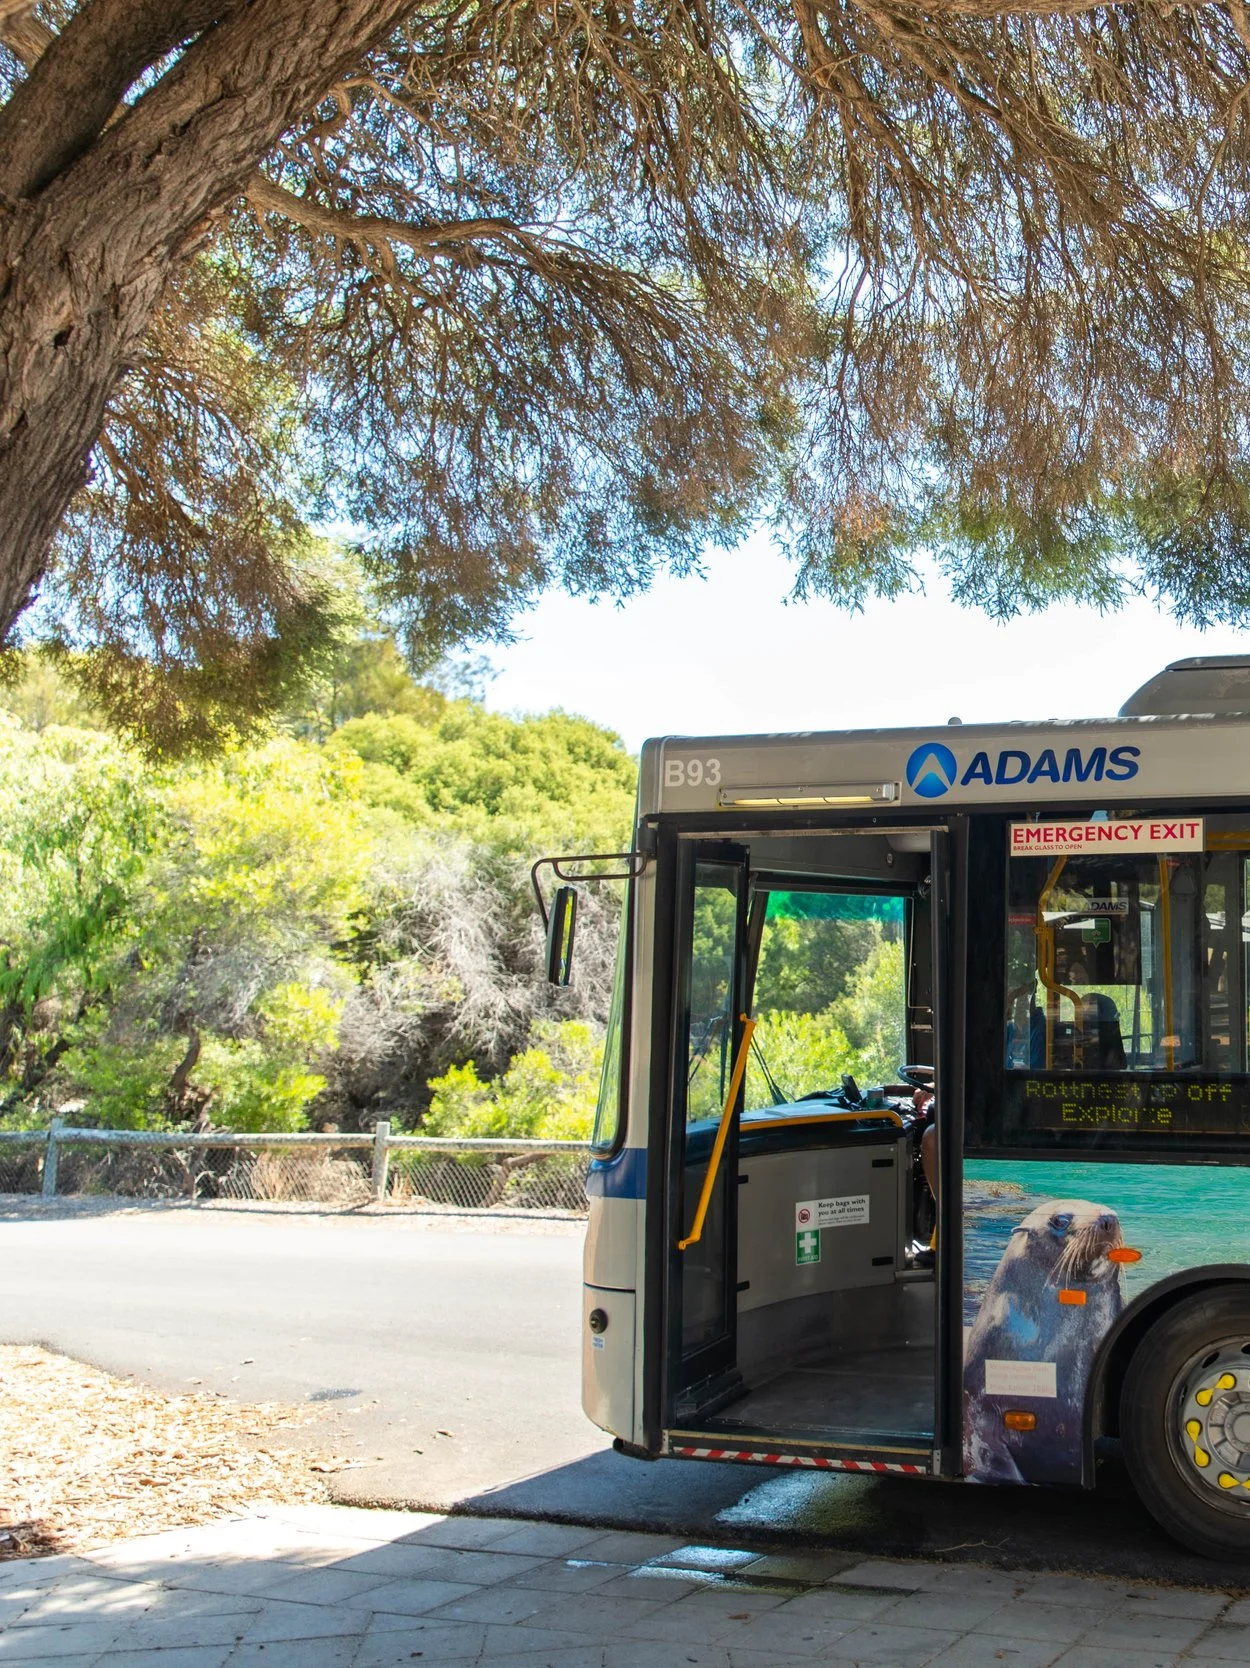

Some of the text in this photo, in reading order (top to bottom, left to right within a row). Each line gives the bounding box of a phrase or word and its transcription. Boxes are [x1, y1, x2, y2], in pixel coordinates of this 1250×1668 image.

[664, 758, 722, 788] B93
[960, 746, 1141, 786] ADAMS
[1013, 823, 1200, 844] EMERGENCY EXIT
[1187, 1083, 1232, 1102] off
